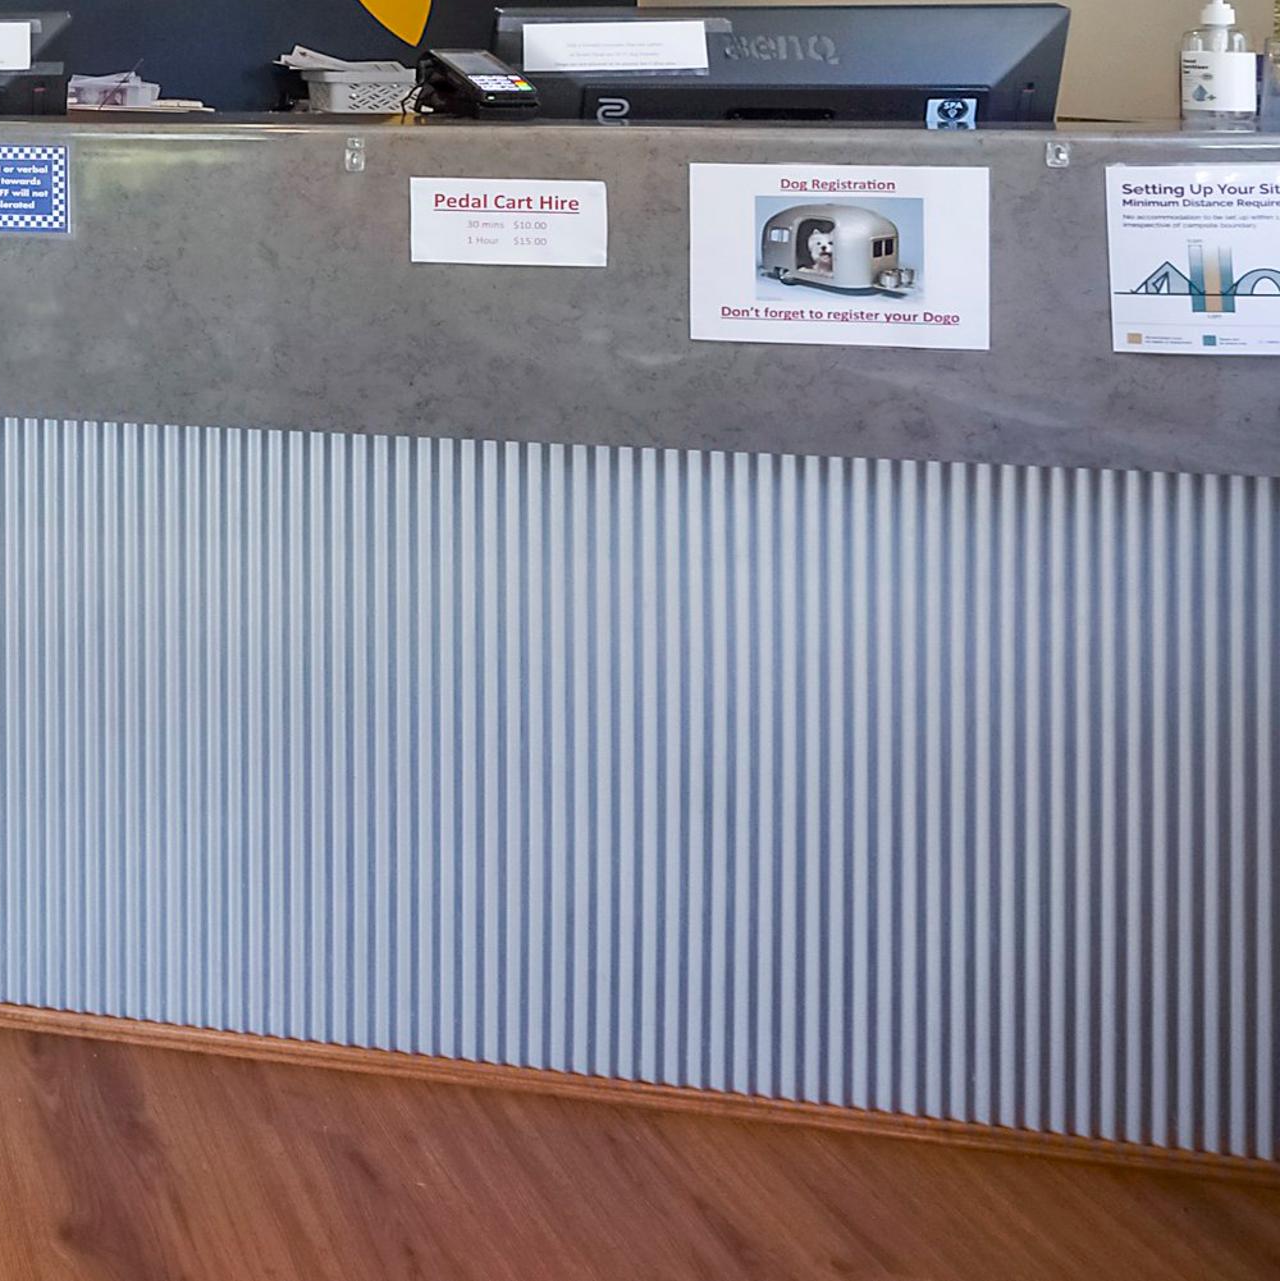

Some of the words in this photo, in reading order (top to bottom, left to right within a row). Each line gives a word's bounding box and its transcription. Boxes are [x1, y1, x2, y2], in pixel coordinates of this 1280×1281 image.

[943, 101, 964, 110] SPA
[16, 165, 48, 174] verbal
[0, 176, 41, 185] towards
[780, 179, 807, 191] Dog
[811, 178, 896, 191] Registration
[11, 188, 29, 197] will
[1121, 183, 1185, 198] Setting
[1190, 183, 1213, 197] Up
[1217, 183, 1255, 195] Your
[434, 193, 487, 209] Pedal
[494, 194, 533, 209] Cart
[539, 195, 580, 211] Hire
[1122, 198, 1180, 208] Minimum
[1182, 198, 1234, 208] Distance
[467, 220, 480, 229] 30
[482, 221, 505, 230] mins
[513, 220, 547, 230] $10.00
[476, 236, 499, 245] Hour
[513, 236, 548, 246] $15.00
[721, 306, 760, 318] Don't
[764, 306, 805, 321] forget
[808, 308, 823, 319] to
[827, 309, 880, 322] register
[884, 312, 919, 323] your
[922, 312, 961, 325] Dogo
